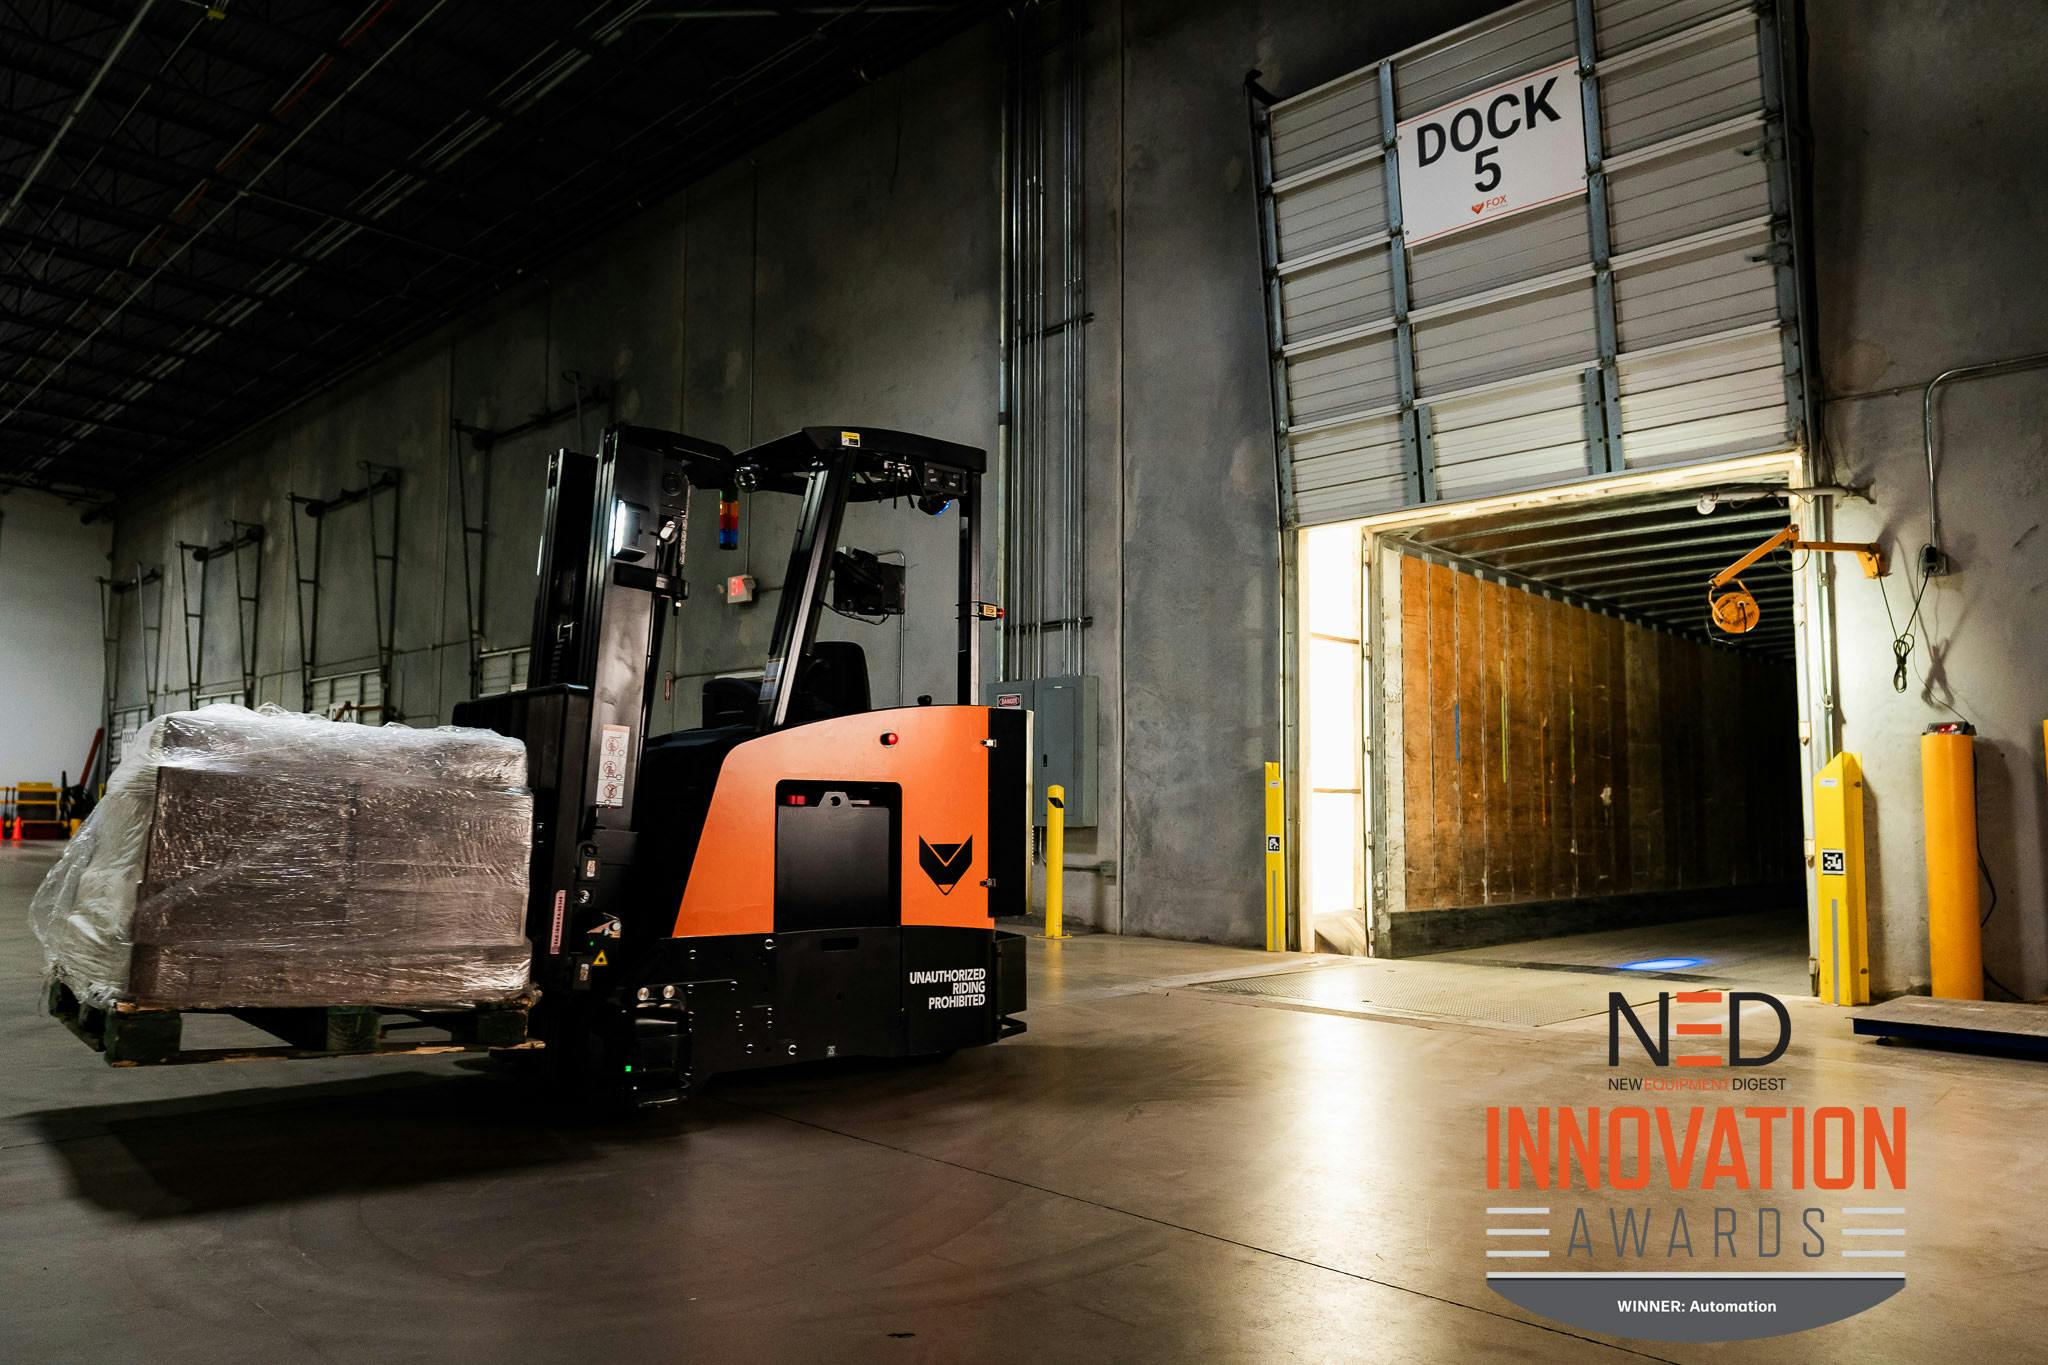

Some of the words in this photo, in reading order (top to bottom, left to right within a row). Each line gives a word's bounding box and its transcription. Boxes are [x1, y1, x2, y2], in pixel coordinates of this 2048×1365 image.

[1416, 76, 1562, 168] DOCK
[1474, 145, 1502, 193] 5
[1486, 194, 1507, 208] FOX
[909, 968, 986, 984] UNAUTHORIZED
[952, 981, 986, 994] RIDING
[928, 994, 985, 1010] PROHIBITED
